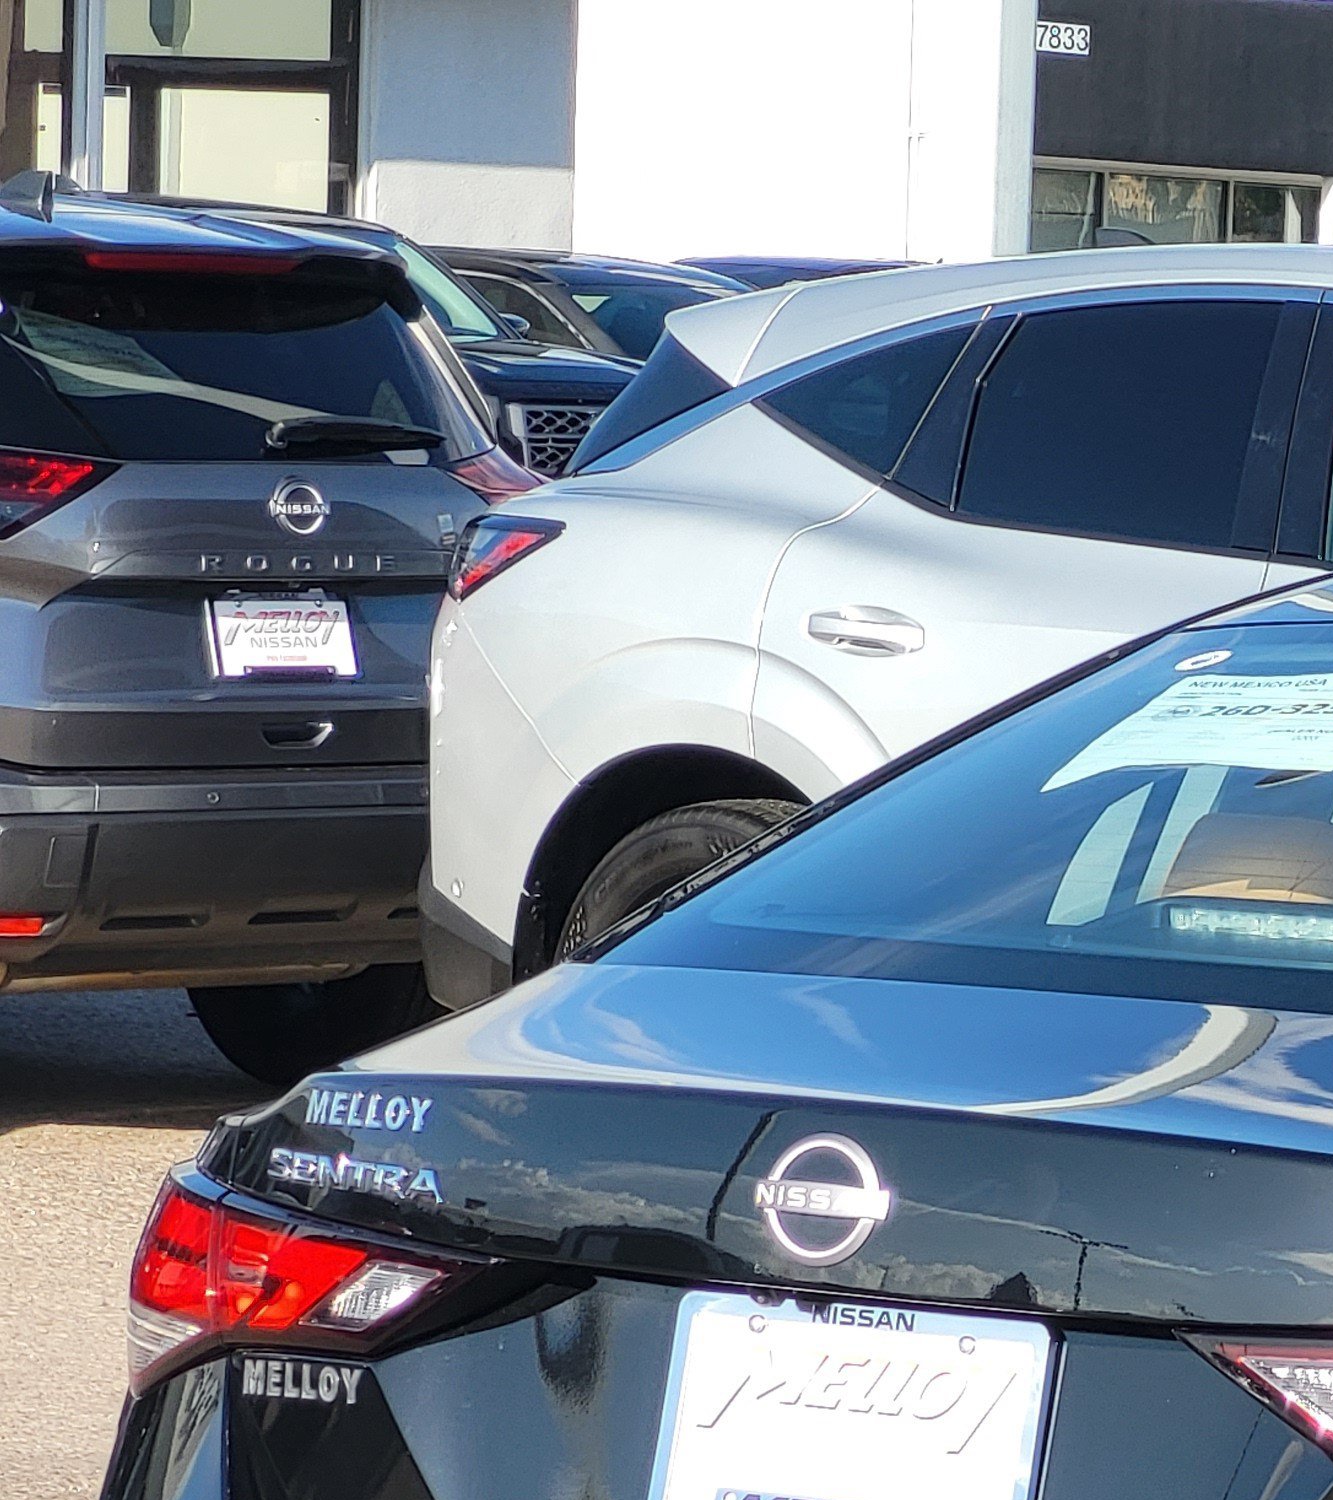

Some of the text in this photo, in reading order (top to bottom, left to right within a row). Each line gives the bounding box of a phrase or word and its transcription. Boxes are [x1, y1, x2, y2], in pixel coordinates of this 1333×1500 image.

[1037, 24, 1089, 51] 7833
[275, 502, 330, 515] NISSAN
[200, 554, 396, 572] ROGUE
[224, 610, 340, 646] MELLOY
[251, 637, 318, 648] NISSAN
[1188, 679, 1328, 689] NEW MEXICO USA
[305, 1088, 434, 1134] MELLOY
[267, 1148, 444, 1205] SENTRA
[756, 1182, 876, 1216] NISS
[812, 1304, 916, 1333] NISSAN
[242, 1358, 365, 1406] MELLOY
